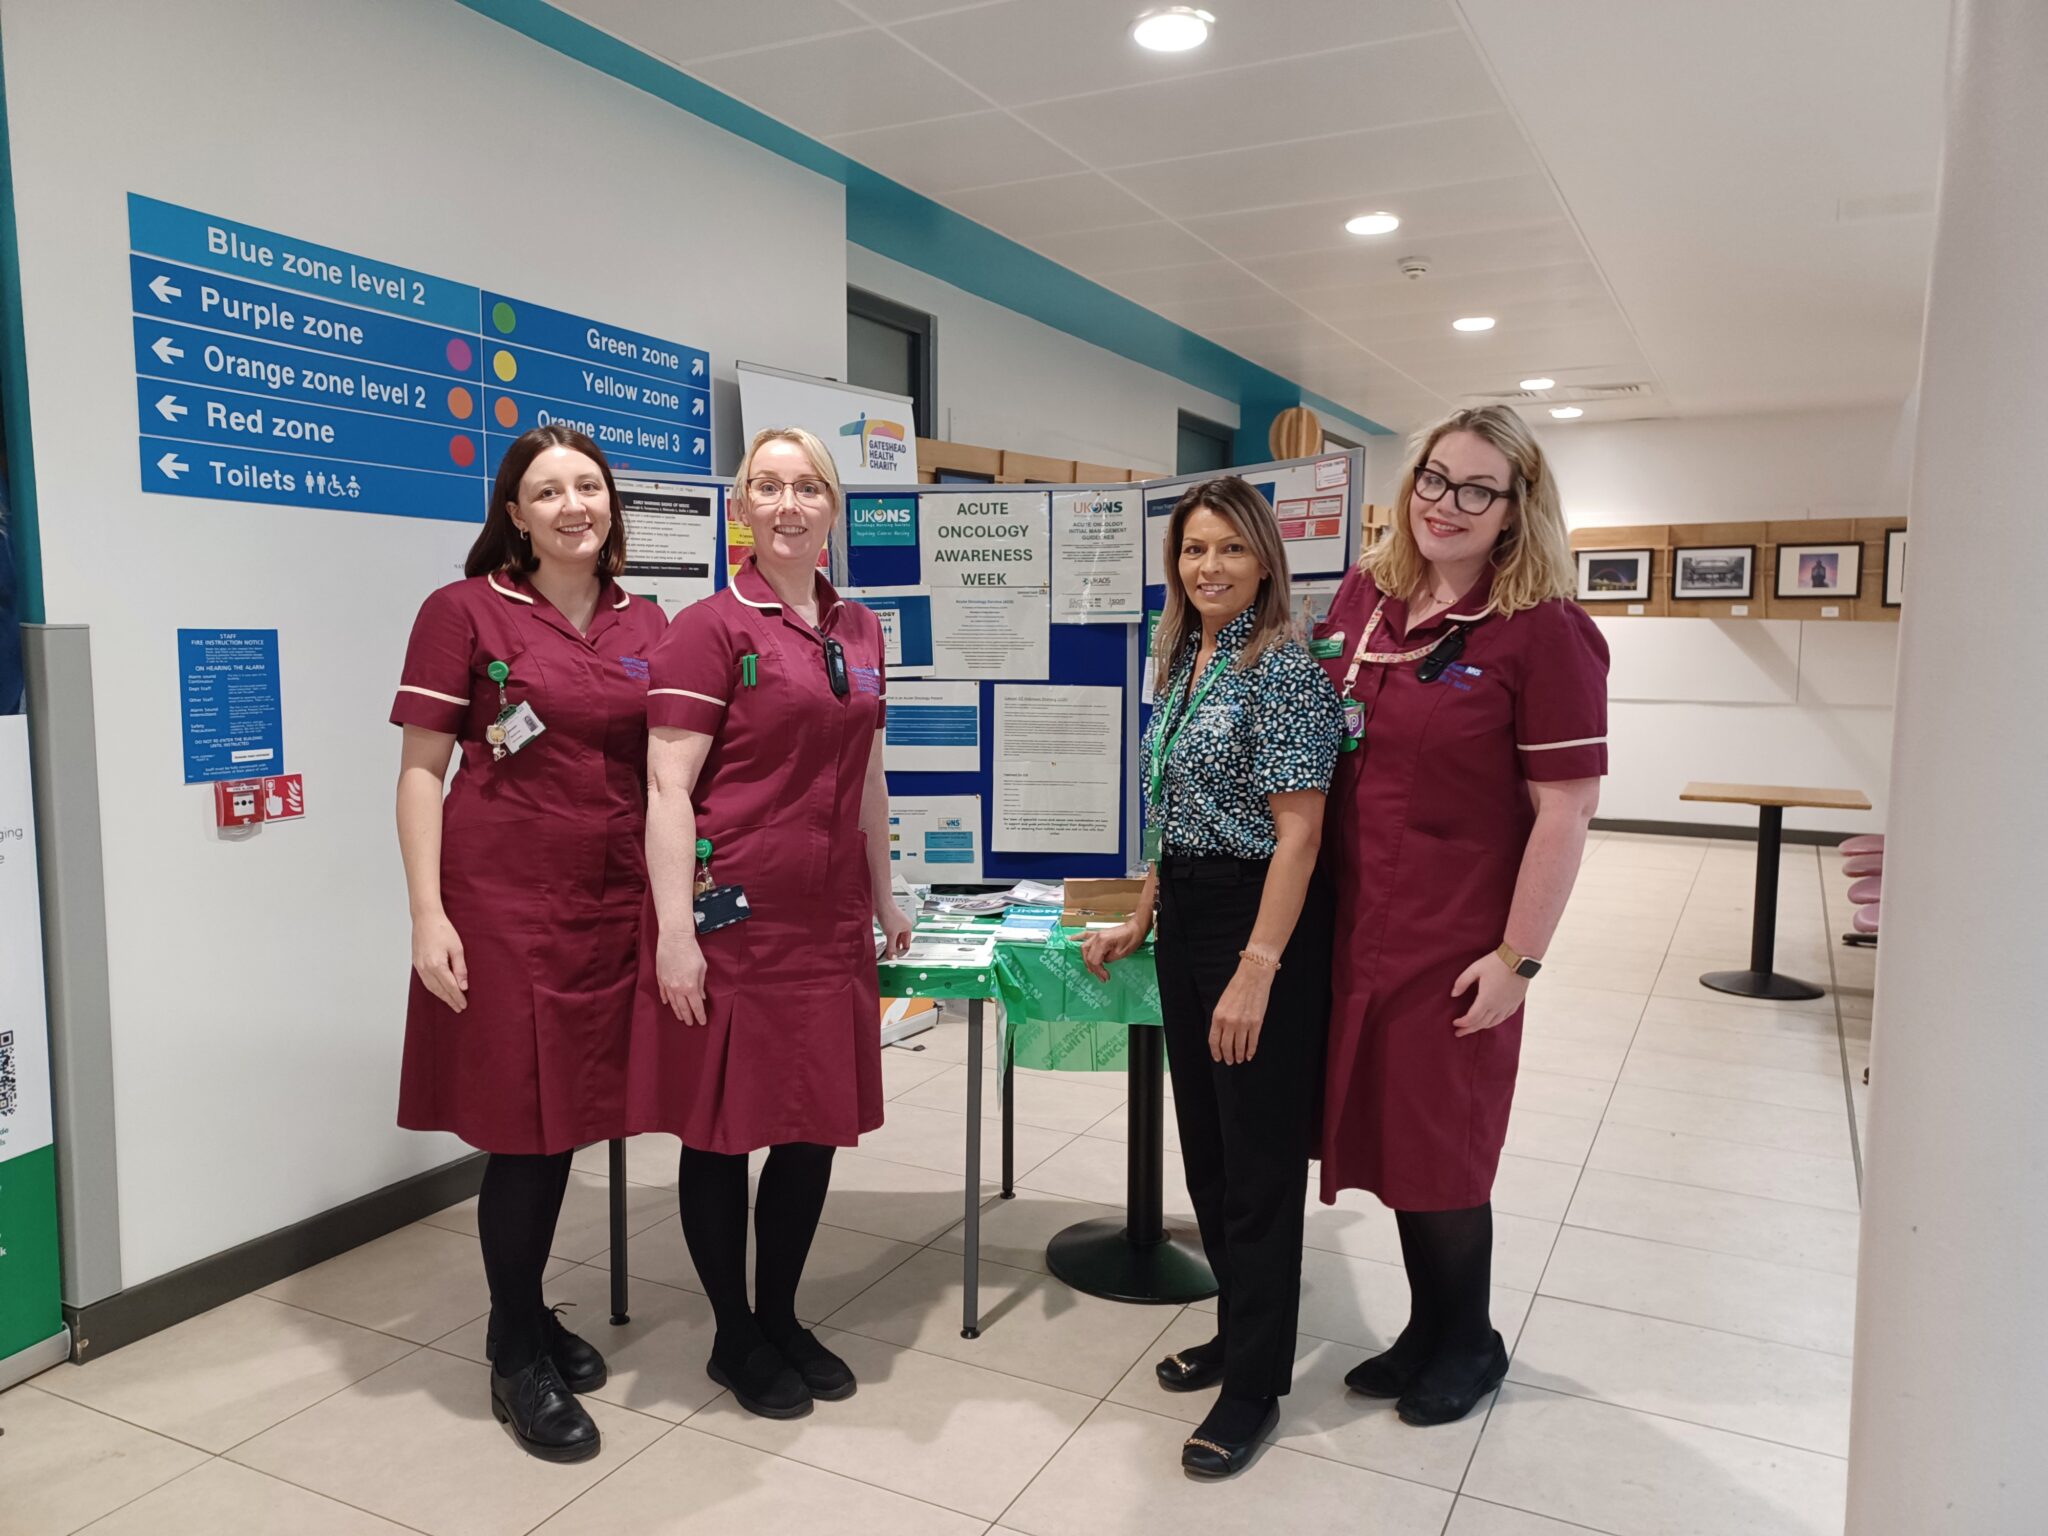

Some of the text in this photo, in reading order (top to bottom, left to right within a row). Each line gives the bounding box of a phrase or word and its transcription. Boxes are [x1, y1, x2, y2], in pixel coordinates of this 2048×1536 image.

[207, 226, 425, 305] Blue zone level 2
[201, 286, 364, 345] Purple zone
[586, 328, 679, 370] Green zone
[204, 345, 427, 409] Orange zone level 2
[582, 370, 679, 410] Yellow zone
[207, 401, 335, 444] Red zone
[599, 425, 633, 445] zone
[637, 427, 668, 451] level
[672, 434, 680, 452] 3
[869, 440, 906, 454] GATESHEAD
[869, 450, 894, 462] HEALTH
[870, 459, 897, 471] CHARITY
[209, 461, 296, 491] Toilets
[854, 509, 911, 523] UKONS
[957, 502, 1009, 515] ACUTE
[1073, 501, 1123, 513] UKONS
[938, 525, 1029, 538] ONCOLOGY
[934, 549, 1033, 562] AWARENESS
[961, 573, 1007, 586] WEEK
[1039, 955, 1065, 982] CANCE
